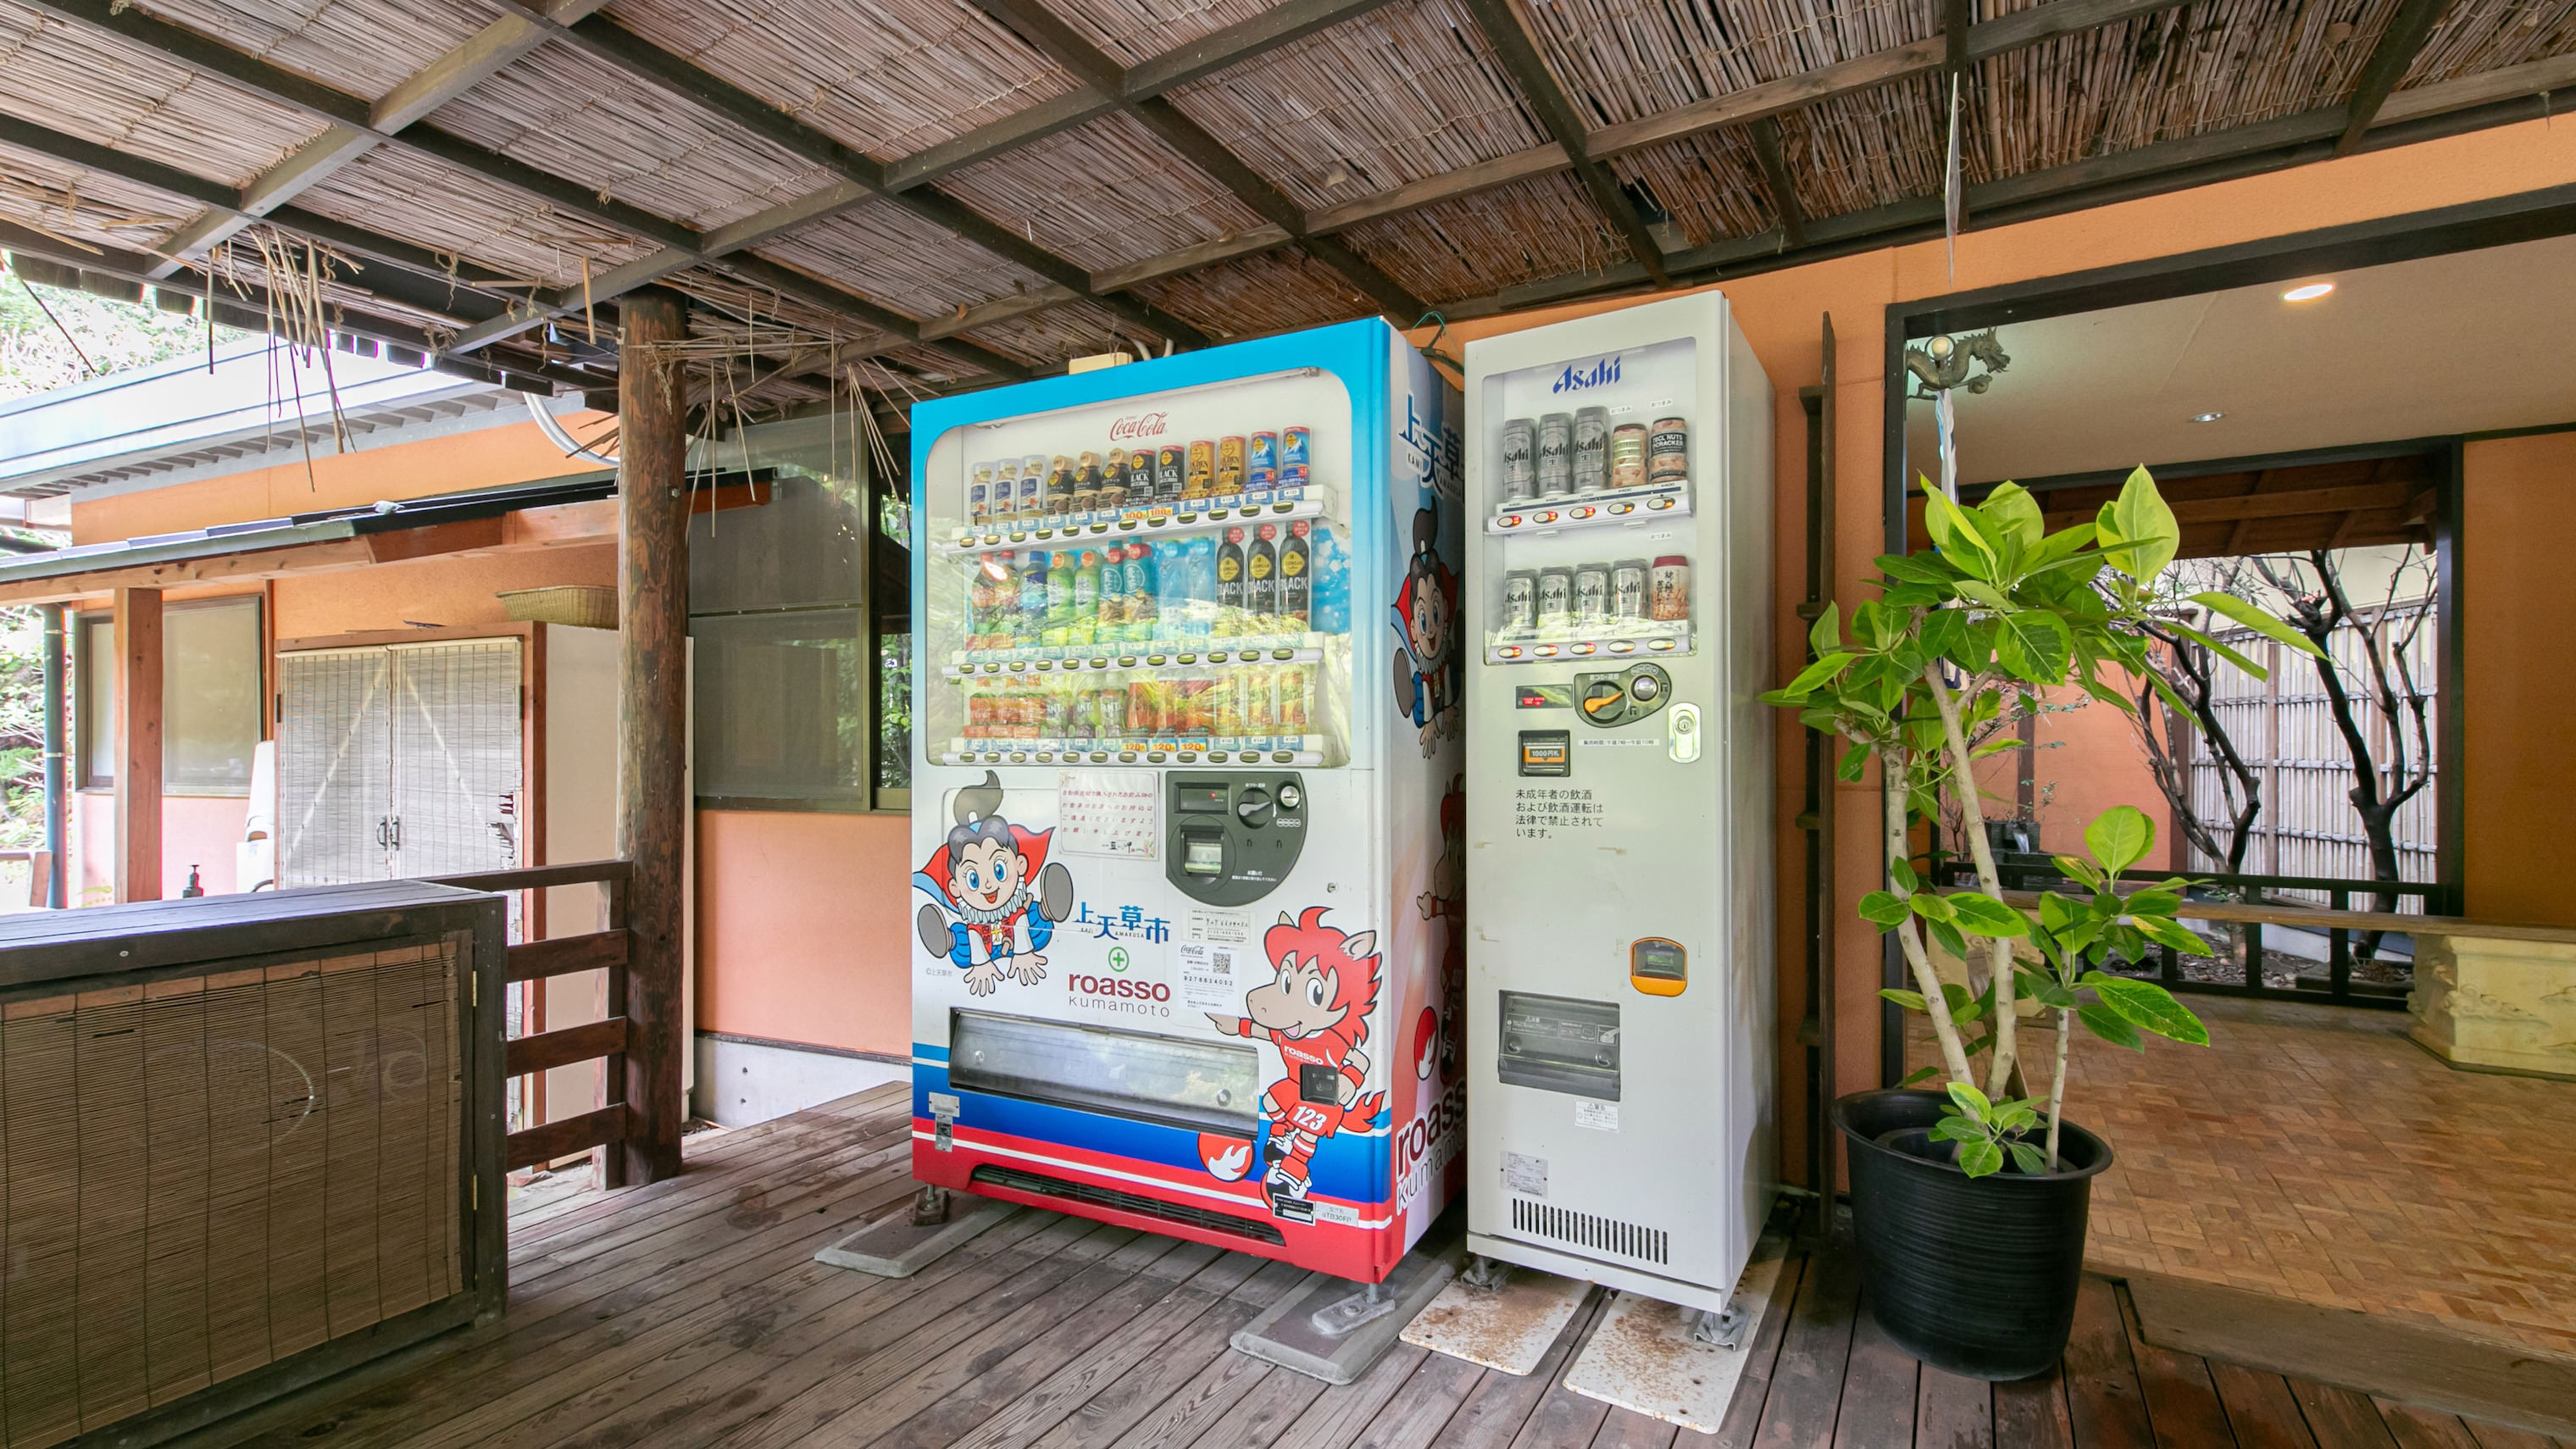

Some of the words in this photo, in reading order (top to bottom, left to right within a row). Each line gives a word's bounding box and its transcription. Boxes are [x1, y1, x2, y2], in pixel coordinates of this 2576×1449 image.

[1552, 356, 1622, 394] Asahi
[1110, 412, 1168, 441] Coca-Cola
[1130, 472, 1149, 482] LACK
[1159, 469, 1178, 479] LACK
[1515, 789, 1592, 800] 未成年者の飲酒
[1515, 802, 1603, 813] および飲酒運転は
[1515, 814, 1604, 827] 法律で禁止されて
[1516, 828, 1552, 839] います。
[1072, 901, 1171, 944] 上天草市
[1069, 973, 1171, 1002] roasso
[1284, 1045, 1324, 1066] roasso
[1292, 1105, 1328, 1132] 123
